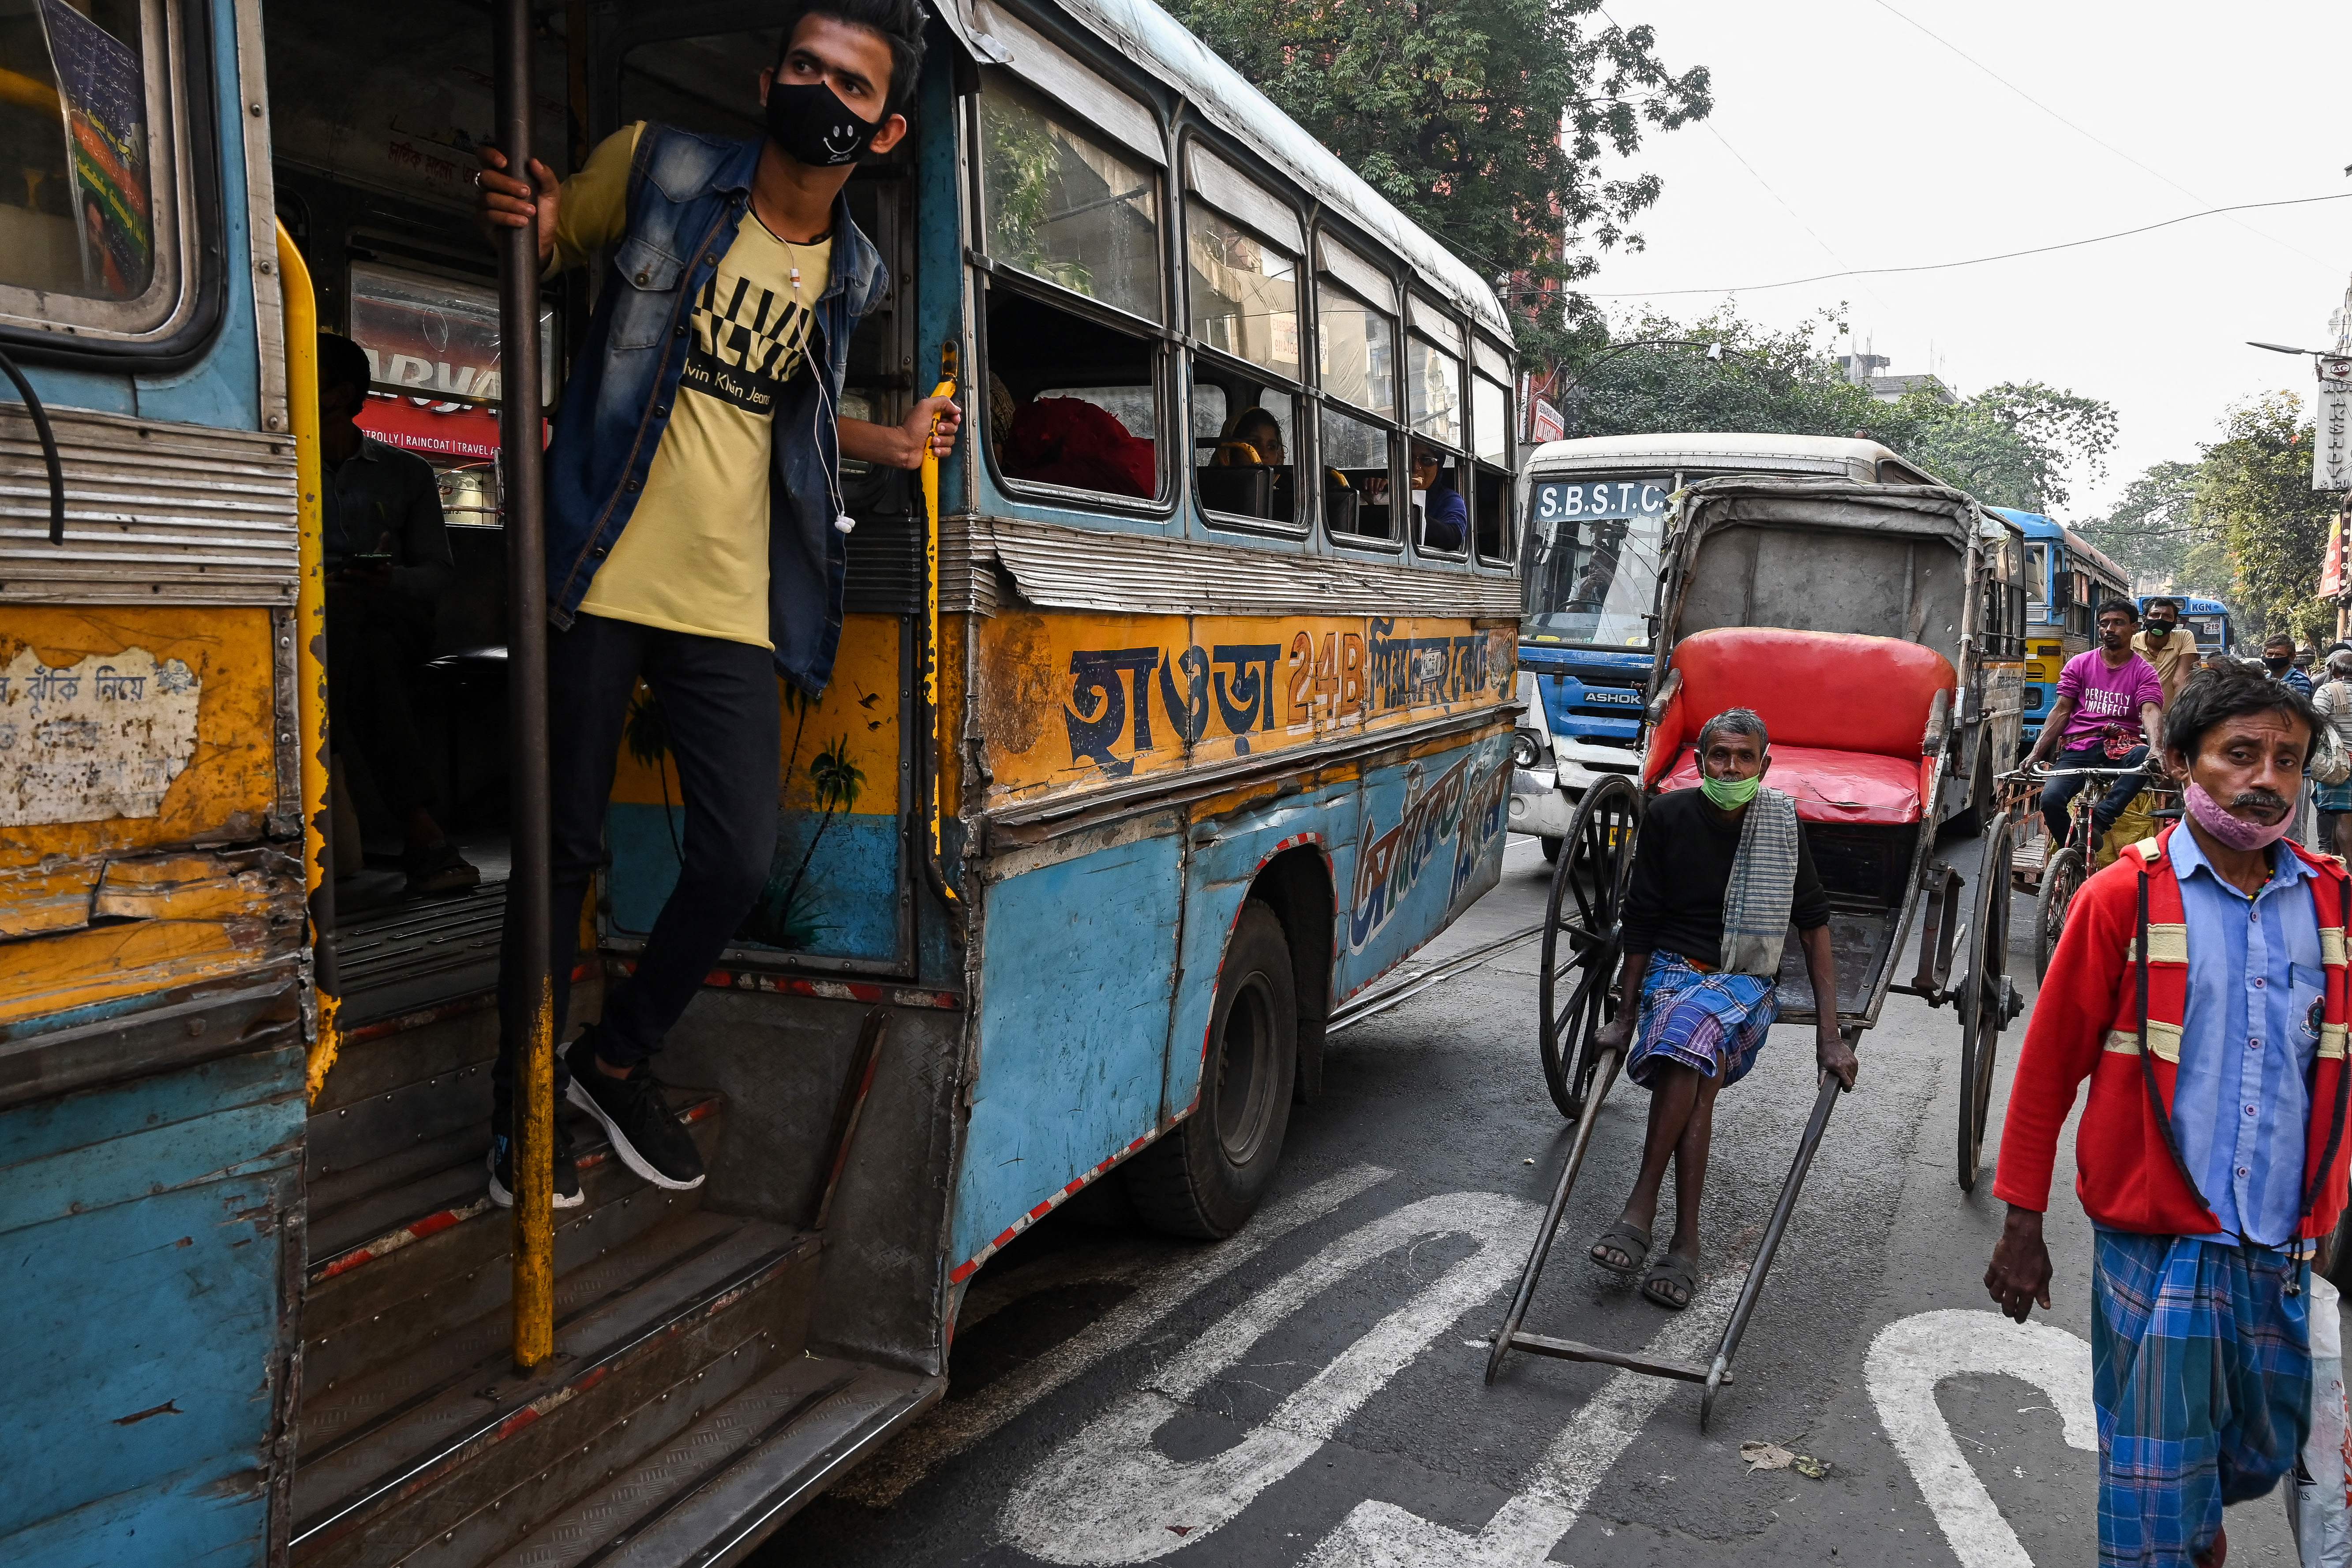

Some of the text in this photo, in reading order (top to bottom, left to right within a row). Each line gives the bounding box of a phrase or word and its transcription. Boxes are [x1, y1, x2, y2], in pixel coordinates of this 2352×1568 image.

[747, 385, 771, 405] Jeans
[406, 435, 450, 451] RAINCOAT
[457, 442, 488, 456] TRAVEL
[2191, 603, 2212, 612] KGN
[26, 665, 81, 714] ঝুঁকি
[95, 665, 147, 703] নিয়ে
[1585, 692, 1640, 704] ASHOK
[2085, 688, 2130, 706] PERFECTLY
[1064, 644, 1281, 777] হাওড়া
[1287, 631, 1366, 734] 24B
[2085, 700, 2130, 716] IMPERFECT
